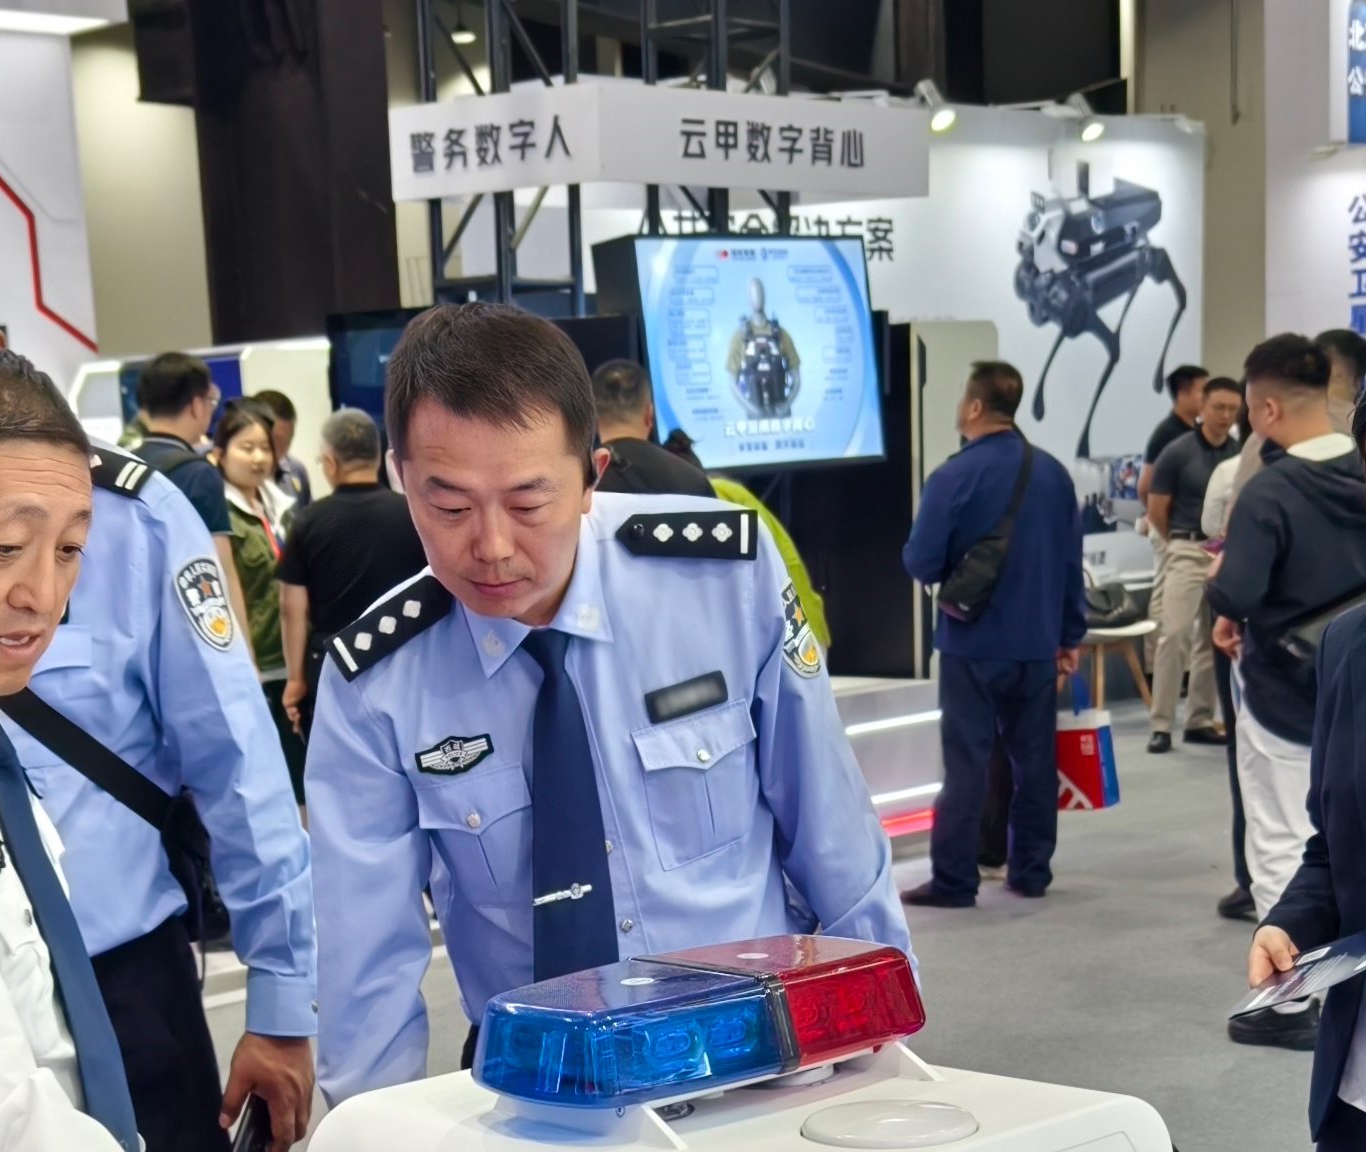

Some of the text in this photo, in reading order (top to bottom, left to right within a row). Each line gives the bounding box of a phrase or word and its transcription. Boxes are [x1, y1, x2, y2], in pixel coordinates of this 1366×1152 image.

[410, 115, 571, 172] 警务数字人
[681, 117, 865, 169] 云甲数字背心
